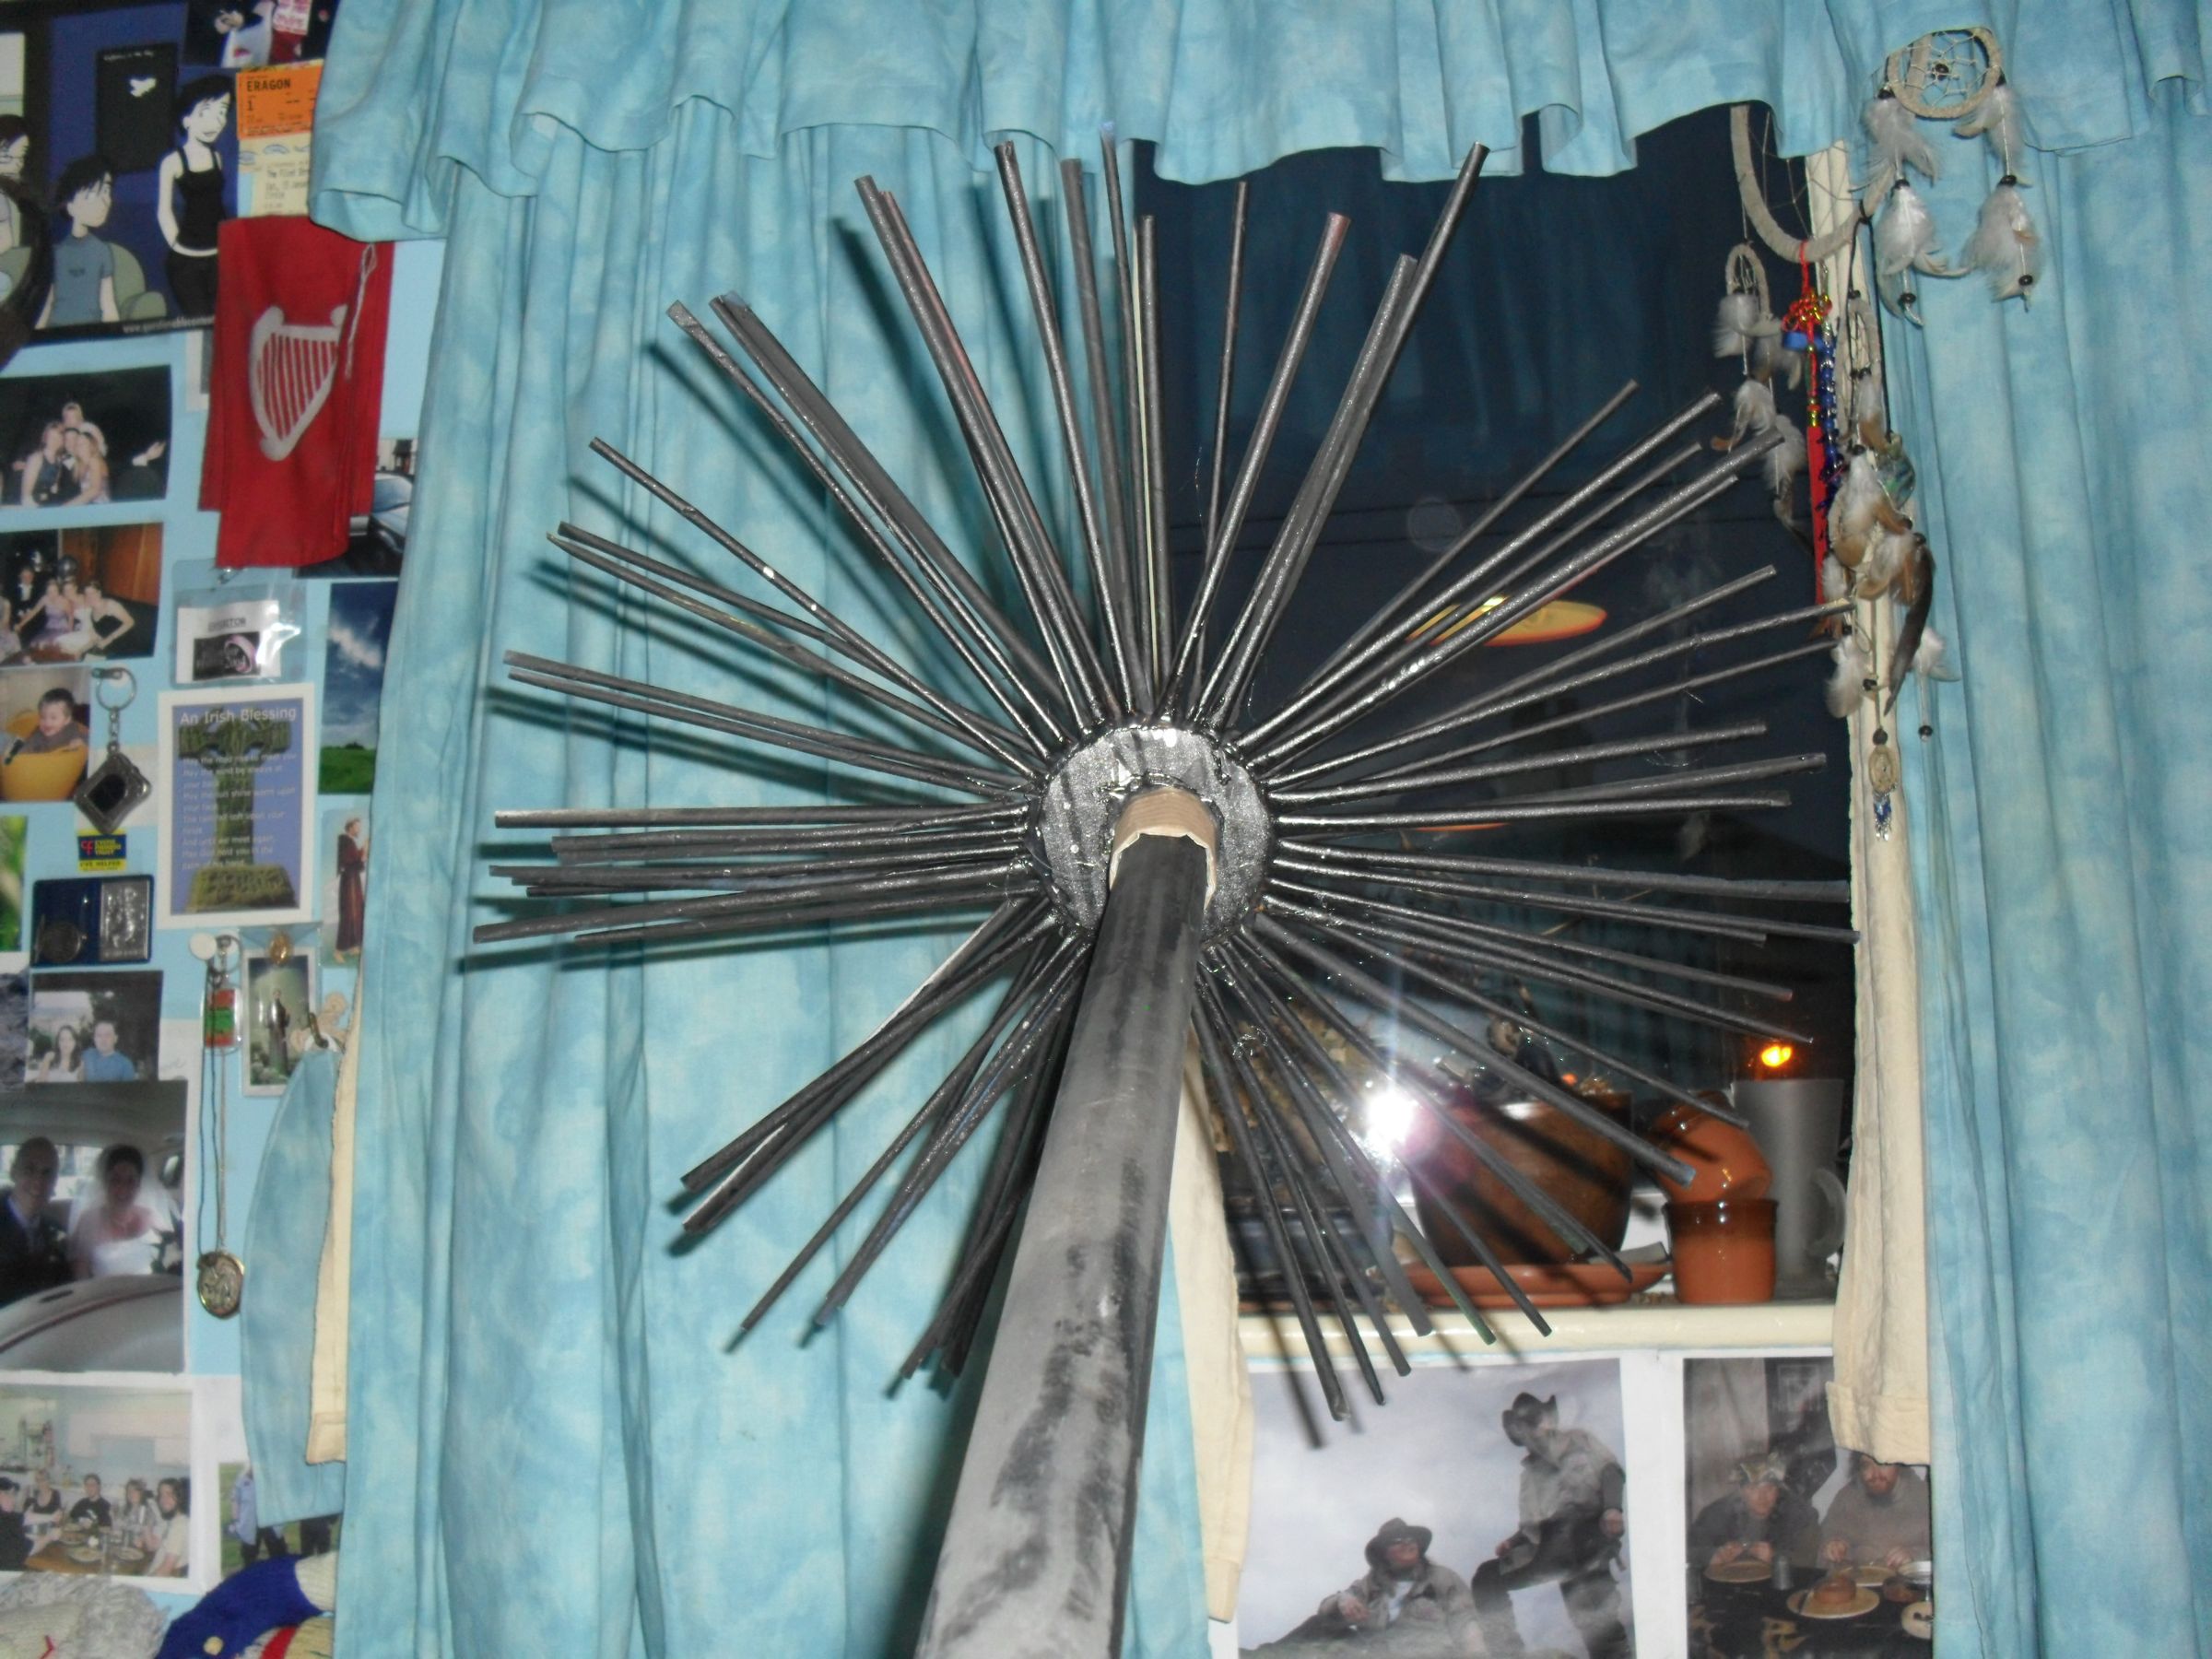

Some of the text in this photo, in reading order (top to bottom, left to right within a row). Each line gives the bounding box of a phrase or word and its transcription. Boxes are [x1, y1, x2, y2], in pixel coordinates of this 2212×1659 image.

[247, 78, 291, 92] ERAGON
[180, 706, 297, 725] An Irish Blessing
